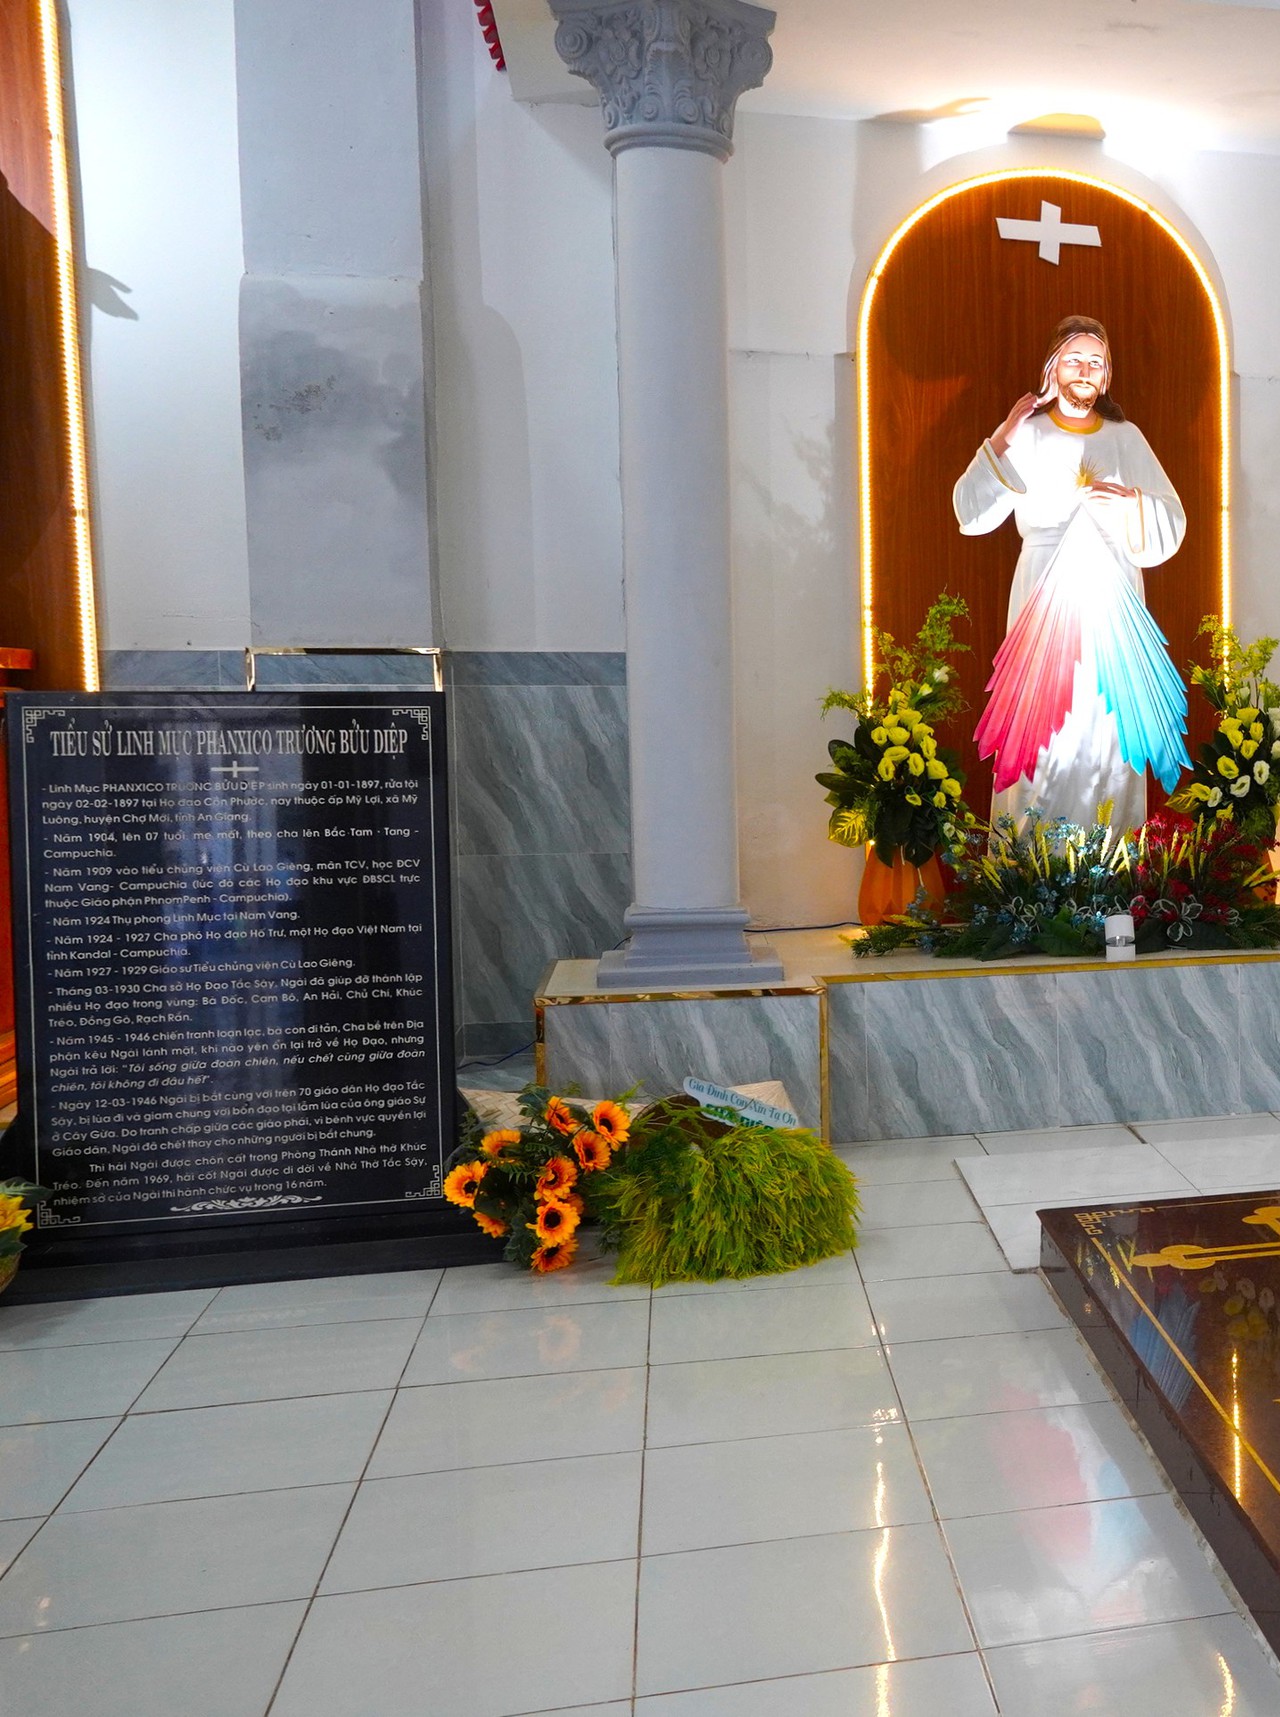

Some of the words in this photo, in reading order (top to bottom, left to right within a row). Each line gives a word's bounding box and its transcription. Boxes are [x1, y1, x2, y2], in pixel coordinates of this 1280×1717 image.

[50, 719, 88, 756] TIỂU
[91, 719, 112, 756] SỬ
[116, 730, 154, 755] LINH
[158, 730, 193, 761] MỤC
[197, 728, 272, 756] PHANXICO
[275, 724, 336, 755] TRƯƠNG
[339, 718, 369, 754] BỬU
[373, 721, 408, 759] DIỆP
[689, 1078, 705, 1093] Gia
[730, 1092, 748, 1109] Con
[750, 1100, 767, 1116] Xin
